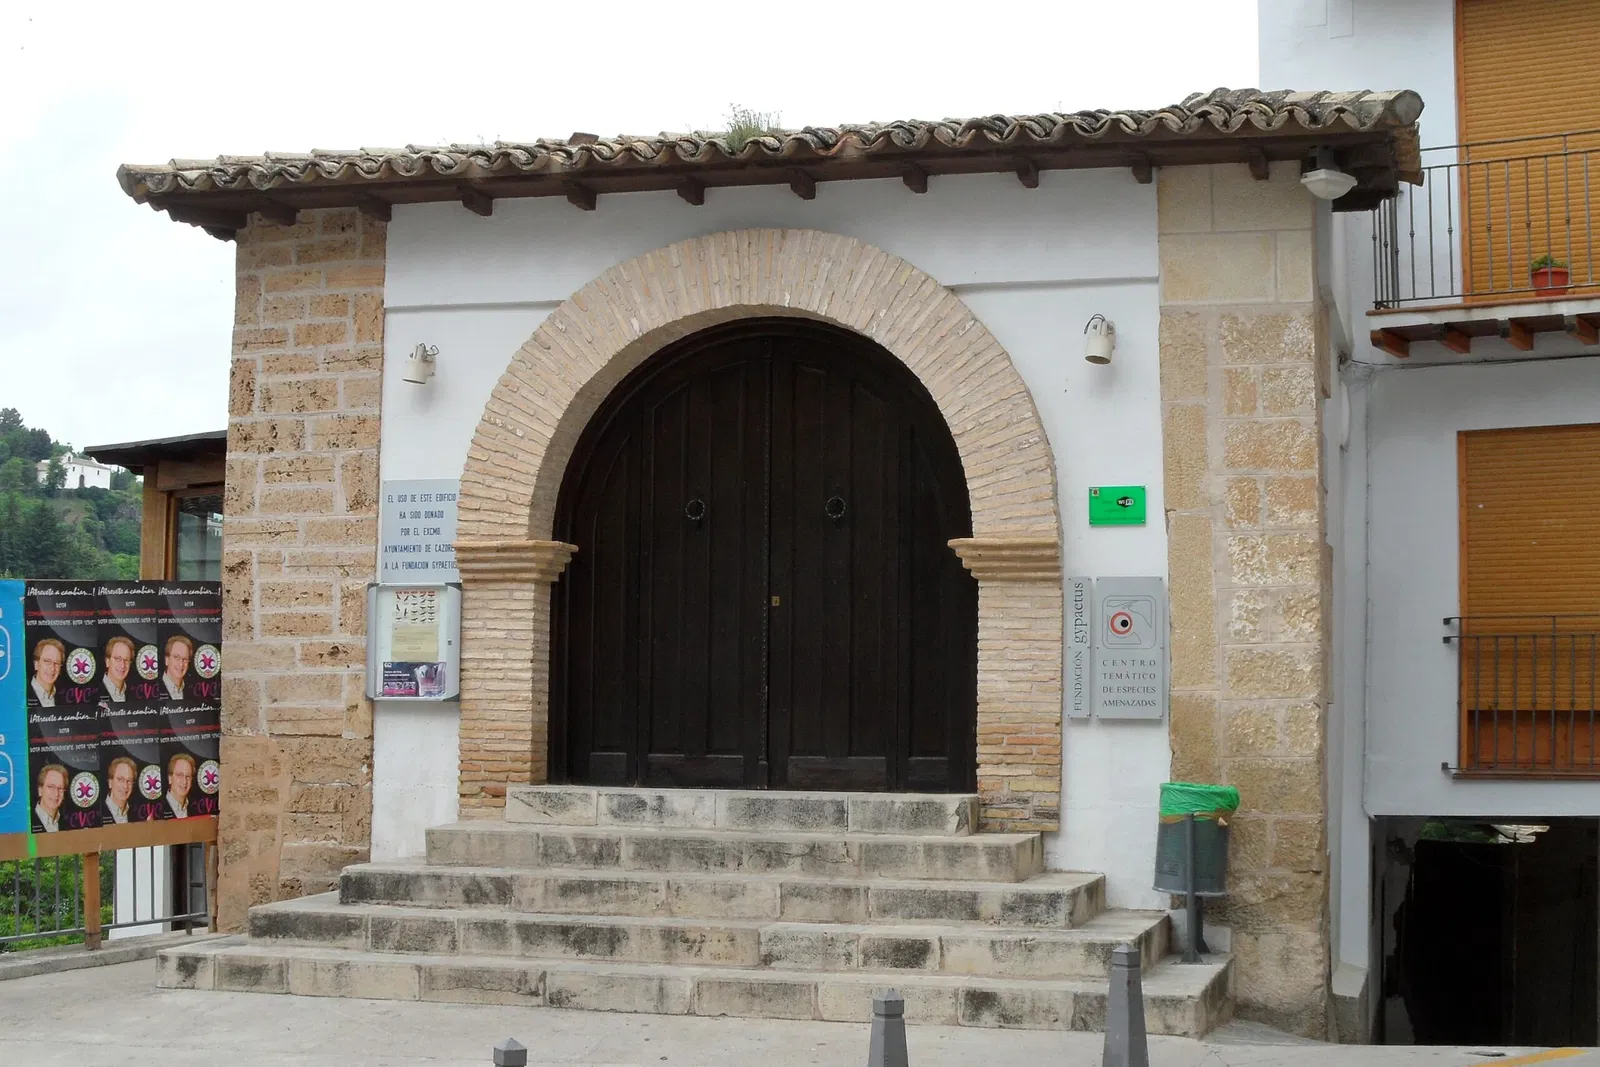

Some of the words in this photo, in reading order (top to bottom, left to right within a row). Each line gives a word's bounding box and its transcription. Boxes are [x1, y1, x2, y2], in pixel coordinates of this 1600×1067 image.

[387, 494, 394, 503] EL
[397, 494, 408, 503] USO
[410, 494, 417, 503] DE
[420, 494, 432, 502] ESTE
[435, 493, 457, 502] EDIFICIO
[399, 511, 407, 519] HA
[410, 510, 421, 519] SIDO
[424, 510, 444, 519] DONADO
[400, 527, 410, 536] POR
[413, 527, 420, 536] EL
[384, 544, 421, 553] AYUNTAMIENTO
[424, 544, 431, 552] DE
[384, 562, 388, 570] A
[391, 561, 399, 570] LA
[402, 561, 429, 570] FUNDACION
[1074, 581, 1088, 645] gypaetus
[1102, 659, 1156, 667] CENTRO
[1074, 650, 1083, 711] FUNDACIÓN
[1102, 686, 1113, 694] DE
[1117, 685, 1156, 694] ESPECIES
[1102, 699, 1156, 708] AMENAZADAS
